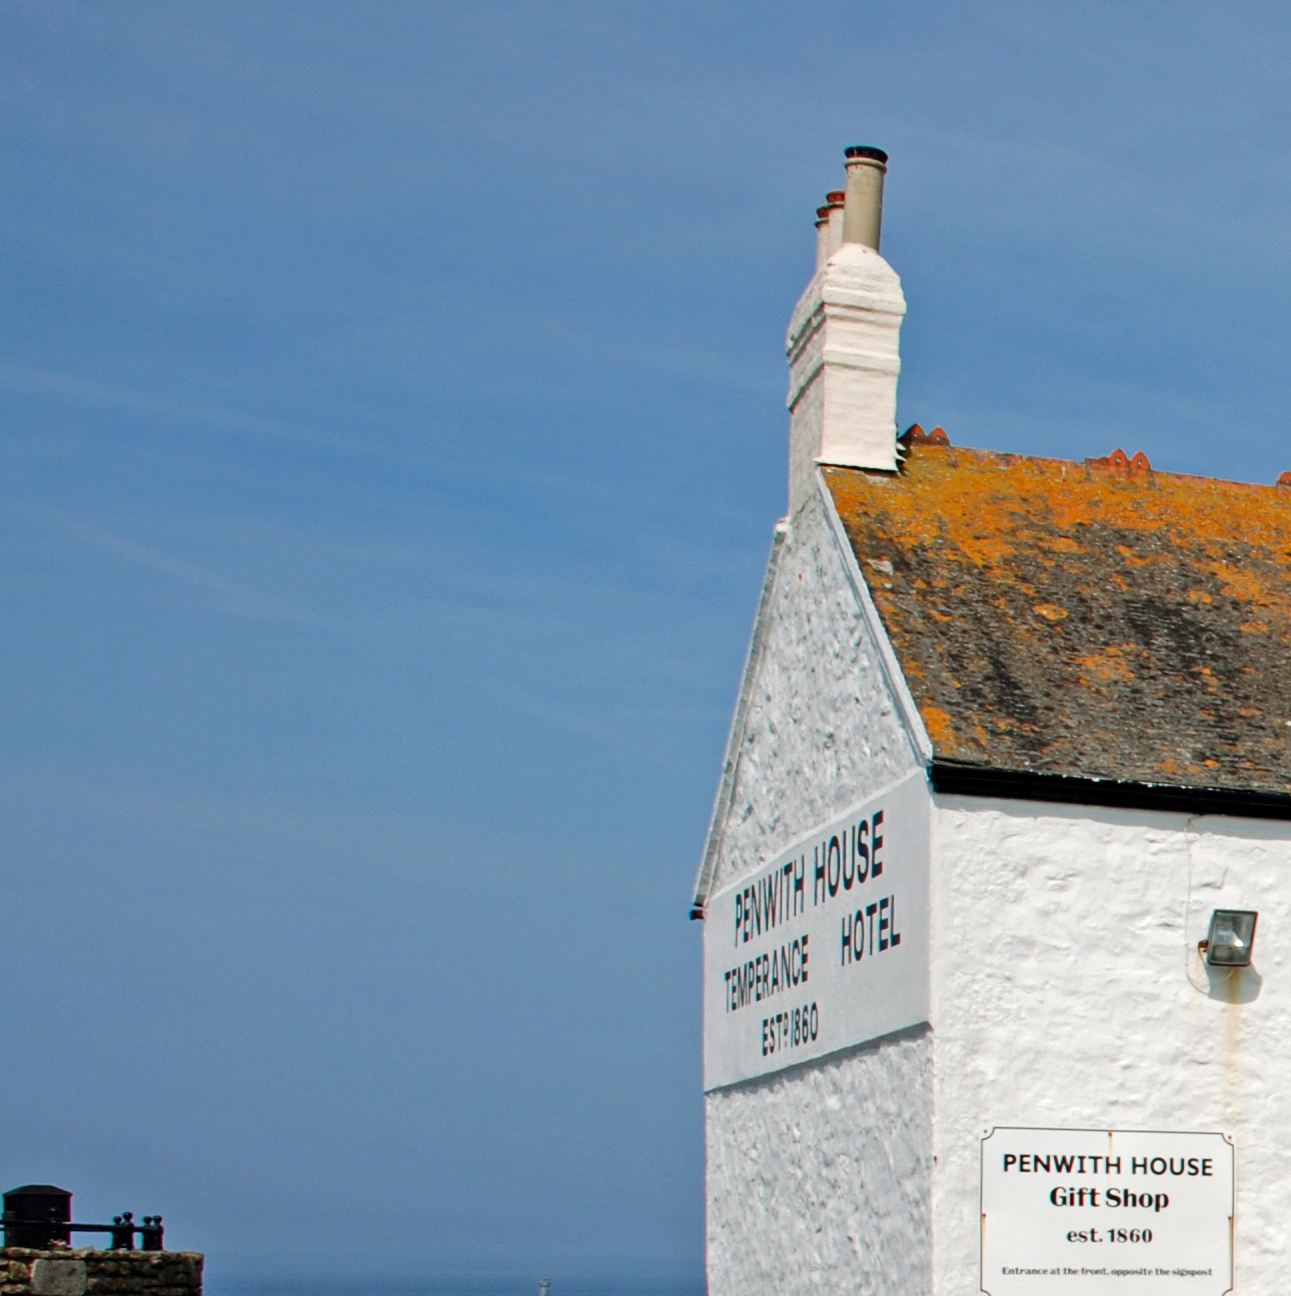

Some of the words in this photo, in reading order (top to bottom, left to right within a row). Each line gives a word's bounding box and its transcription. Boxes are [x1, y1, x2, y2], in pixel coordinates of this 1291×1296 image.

[735, 854, 805, 948] PENWITH
[814, 809, 884, 906] HOUSE
[724, 934, 809, 1013] TEMPERANCE
[841, 894, 901, 966] HOTEL
[790, 1001, 819, 1048] 1860
[1003, 1153, 1122, 1175] PENWITH
[1131, 1156, 1214, 1177] HOUSE
[1049, 1186, 1100, 1208] Gift
[1105, 1187, 1170, 1213] Shop
[1066, 1228, 1103, 1243] est.
[1107, 1228, 1153, 1244] 1860
[1002, 1266, 1049, 1276] Entrance
[1050, 1267, 1061, 1276] at
[1063, 1267, 1080, 1276] the
[1110, 1267, 1153, 1278] opposite
[1154, 1267, 1171, 1277] the
[1171, 1267, 1213, 1278] signpost
